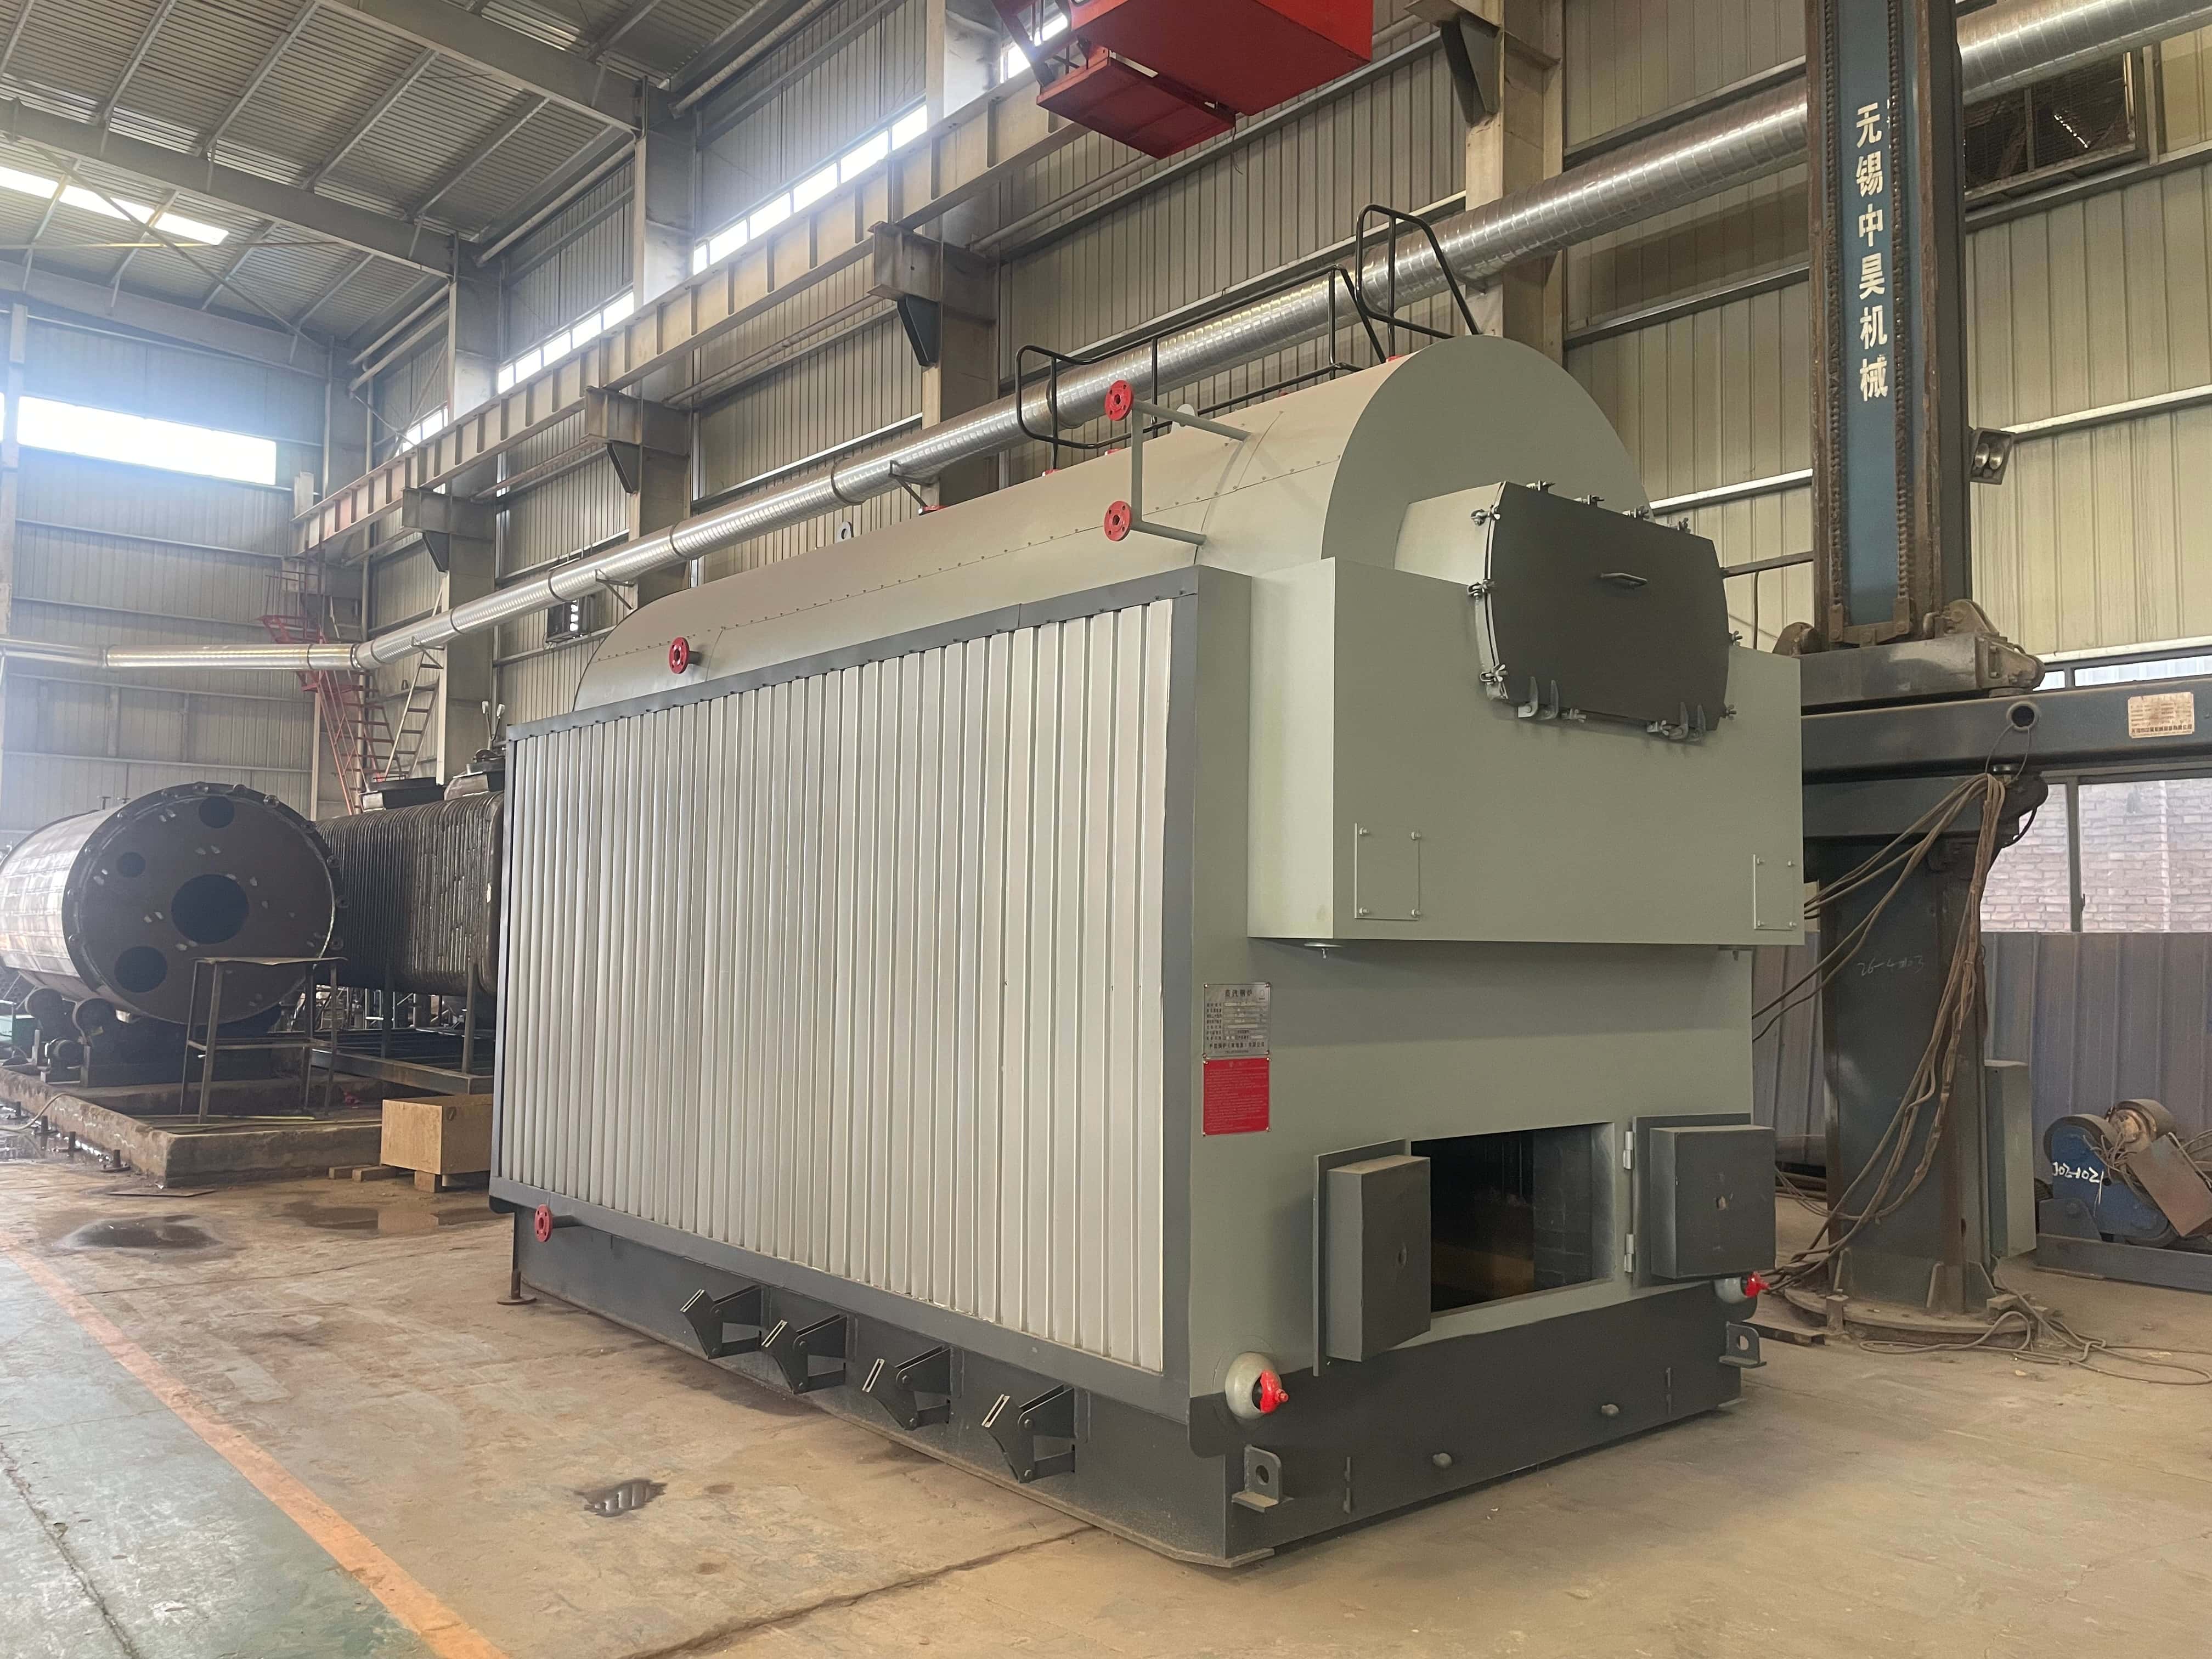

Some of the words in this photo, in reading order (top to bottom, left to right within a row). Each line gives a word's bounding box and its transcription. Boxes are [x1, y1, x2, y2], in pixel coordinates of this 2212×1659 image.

[1855, 101, 1888, 403] 无锡中昊机械
